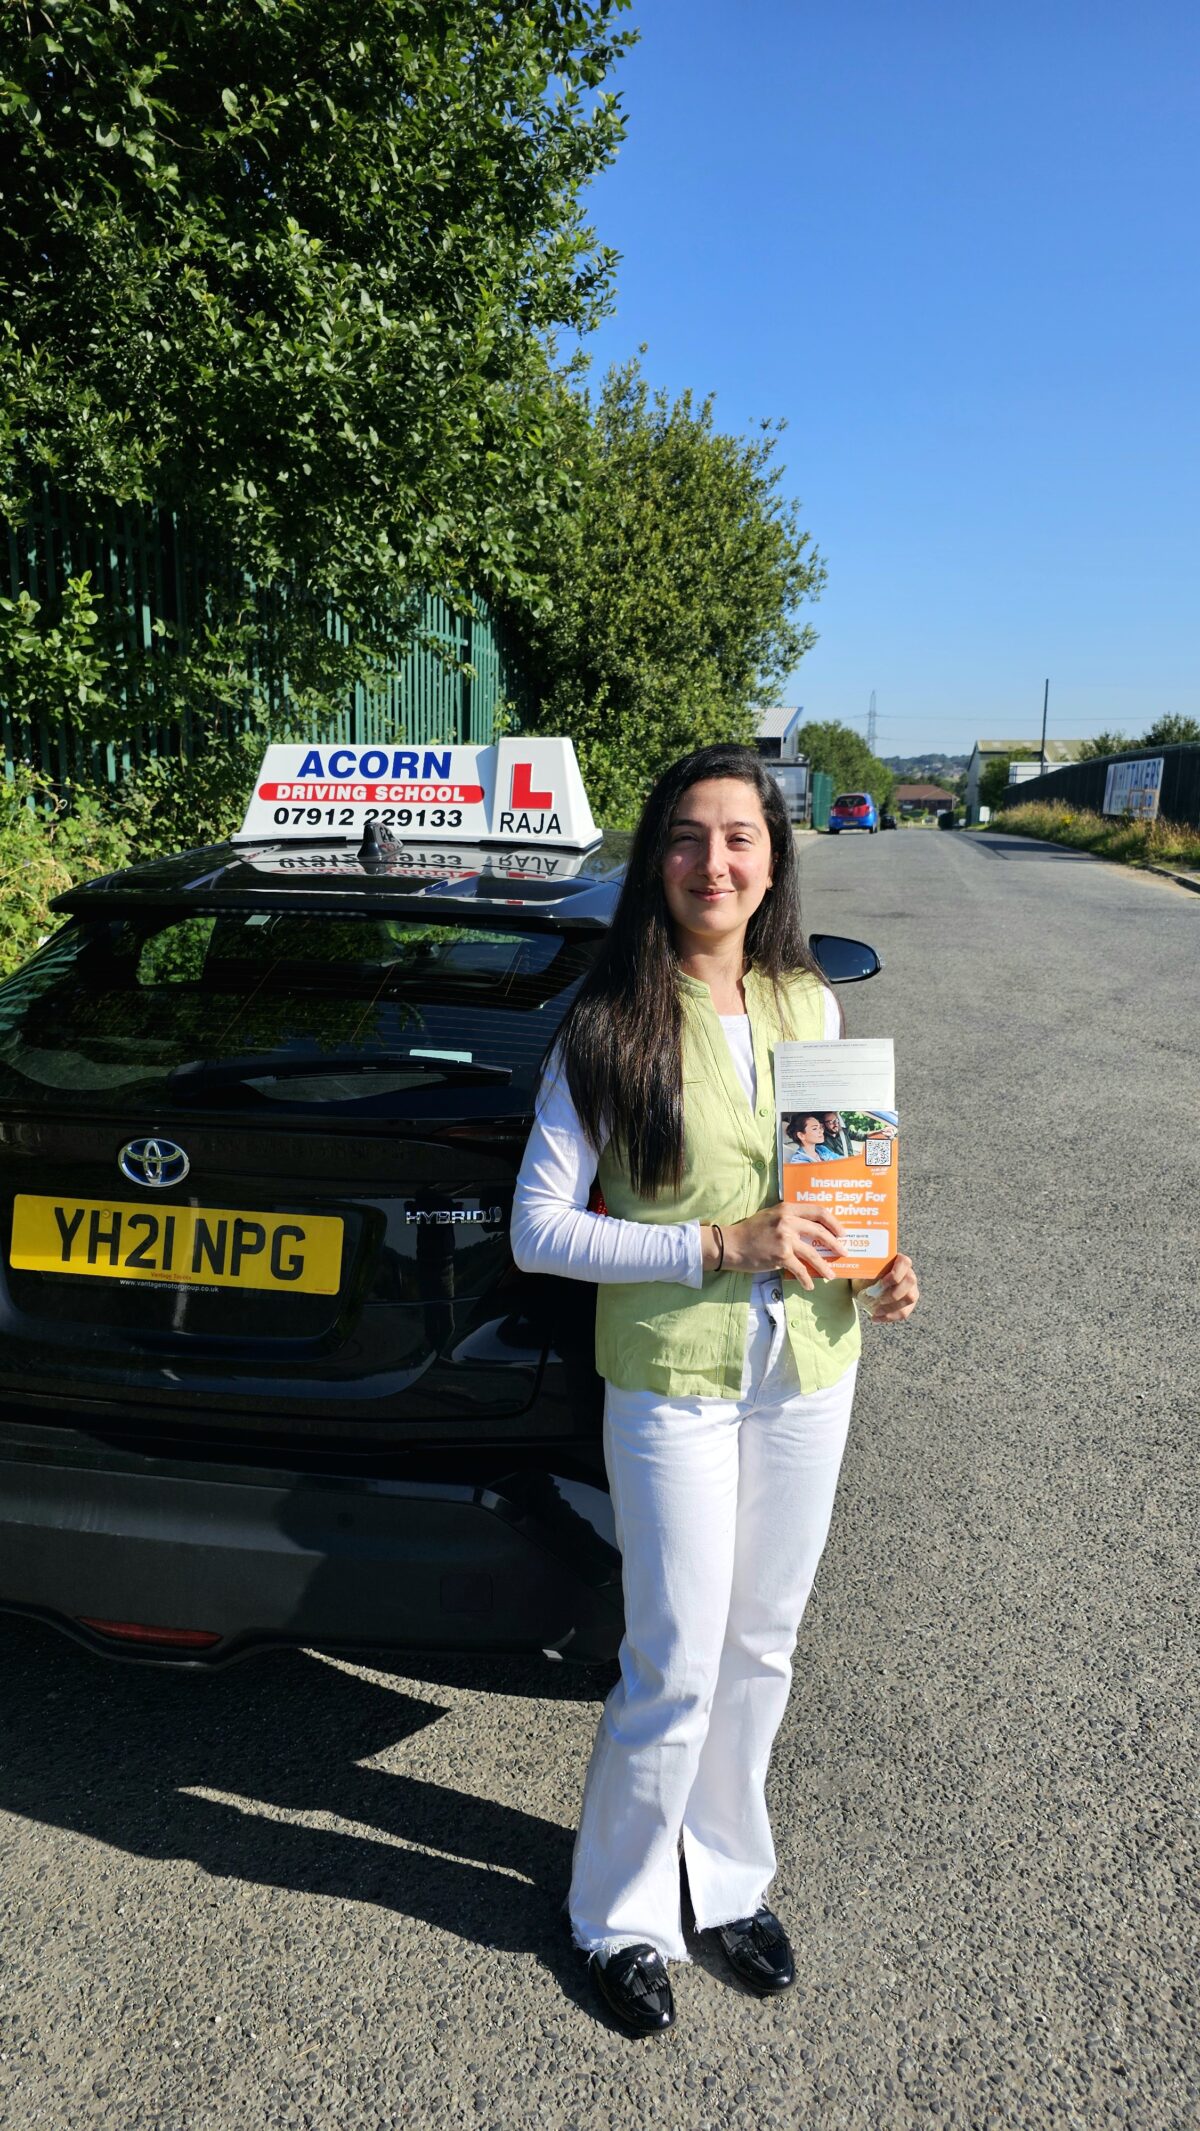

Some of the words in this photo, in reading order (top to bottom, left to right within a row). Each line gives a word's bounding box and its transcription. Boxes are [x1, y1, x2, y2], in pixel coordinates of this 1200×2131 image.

[297, 750, 453, 779] ACORN
[276, 784, 367, 801] DRIVING
[375, 786, 465, 802] SCHOOL
[511, 763, 553, 810] L
[273, 807, 354, 826] 07912
[363, 808, 463, 828] 229133
[499, 811, 562, 835] RAJA
[811, 1177, 873, 1188] Insurance
[796, 1191, 833, 1202] Made
[835, 1191, 863, 1204] Easy
[865, 1191, 887, 1202] For
[406, 1211, 487, 1224] HYBRID
[834, 1203, 879, 1216] Drivers
[54, 1206, 177, 1271] YH21
[191, 1216, 306, 1281] NPG
[119, 1279, 220, 1293] www.vantagemotorgroup.co.uk
